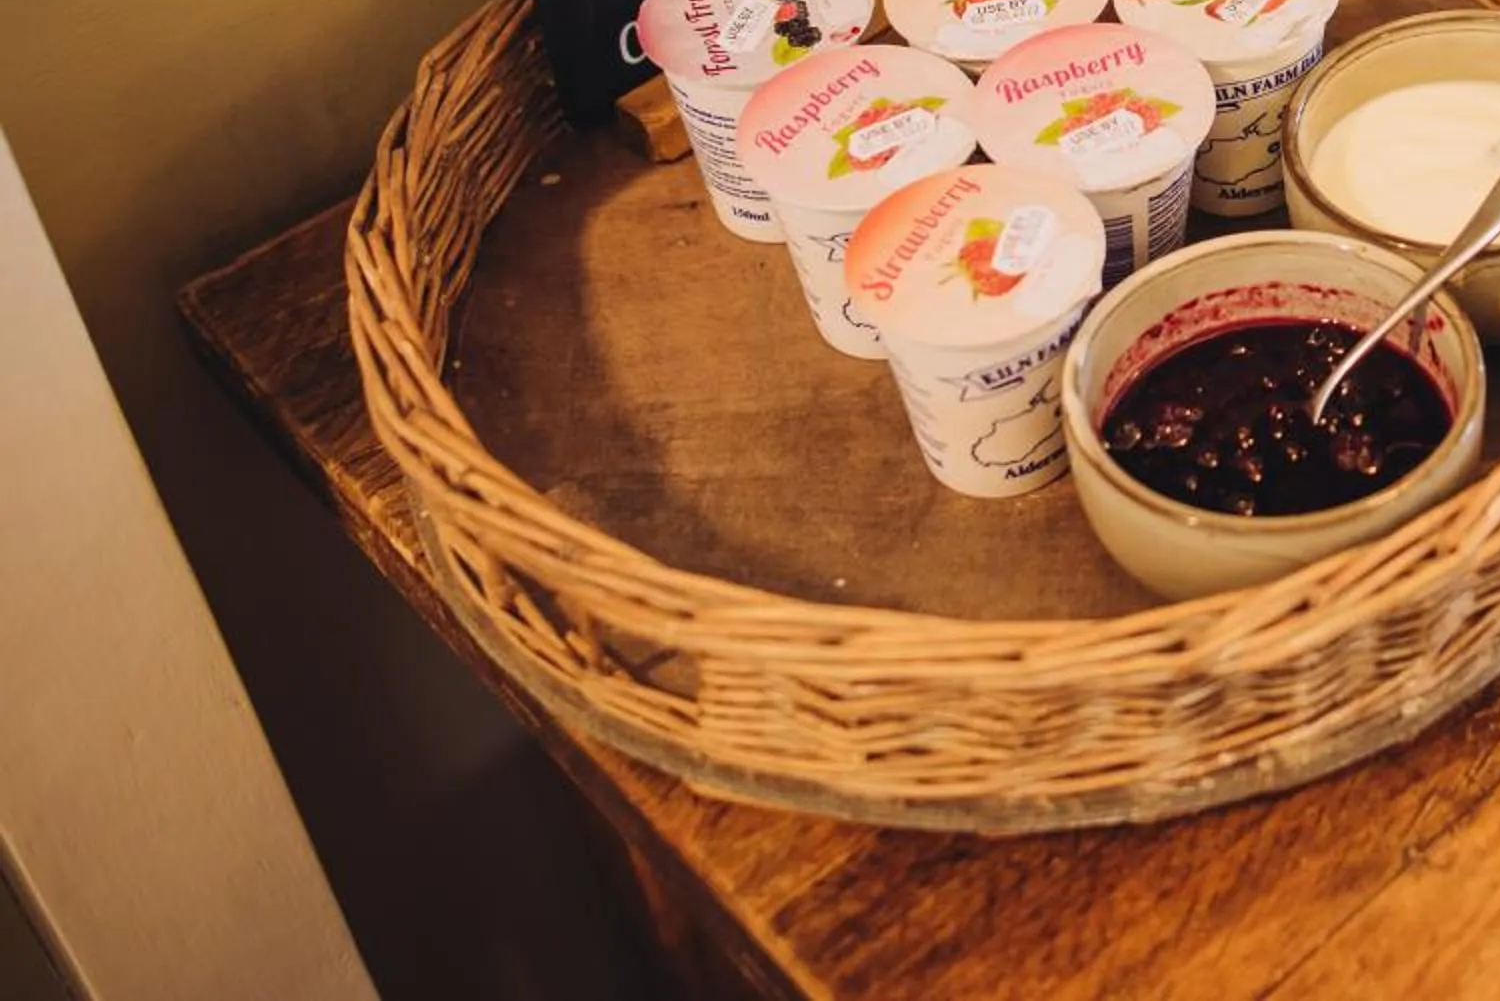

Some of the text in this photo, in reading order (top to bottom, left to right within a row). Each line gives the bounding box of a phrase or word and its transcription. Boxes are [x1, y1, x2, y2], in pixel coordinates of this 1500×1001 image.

[976, 2, 1005, 15] USE
[693, 22, 738, 77] Forest
[995, 42, 1147, 104] Raspberry
[754, 58, 882, 155] Raspberry
[1215, 84, 1247, 102] ILN
[1252, 68, 1299, 95] FARM
[860, 176, 982, 302] Strawberry
